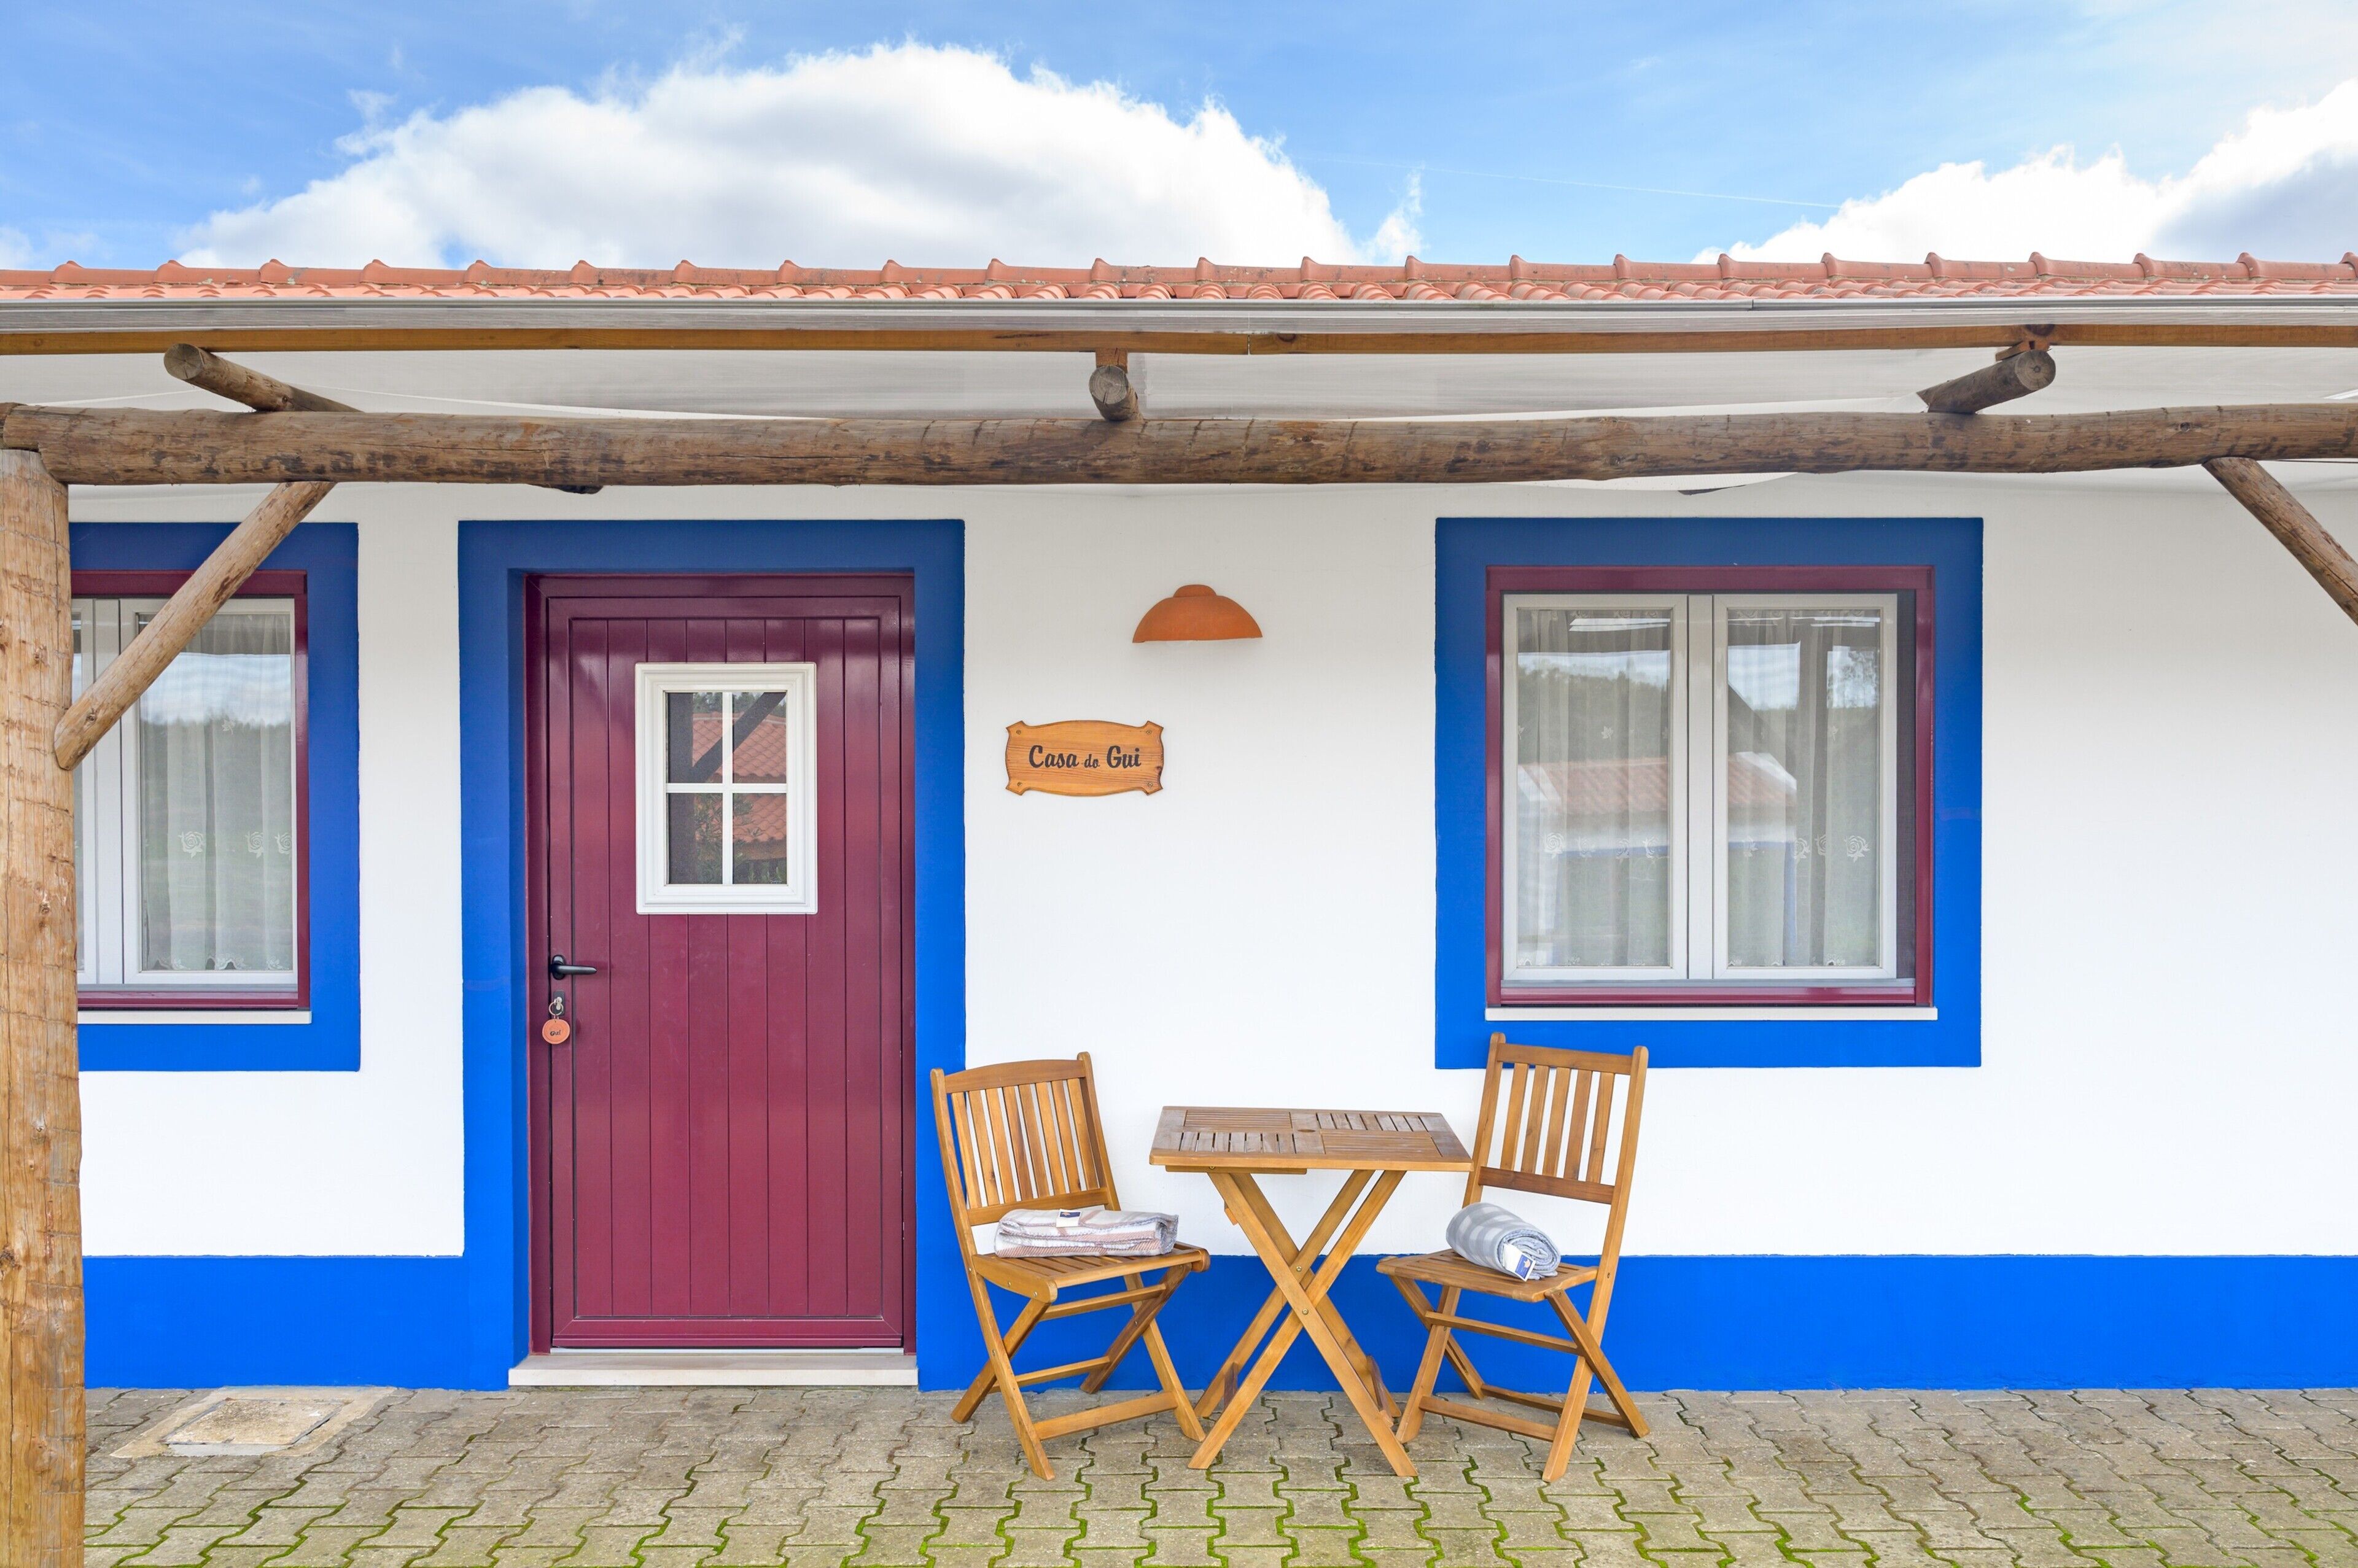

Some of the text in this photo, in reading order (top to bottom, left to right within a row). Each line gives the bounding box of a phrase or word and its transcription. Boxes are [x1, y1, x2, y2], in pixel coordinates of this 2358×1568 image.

[1029, 745, 1142, 769] Casa do Gui
